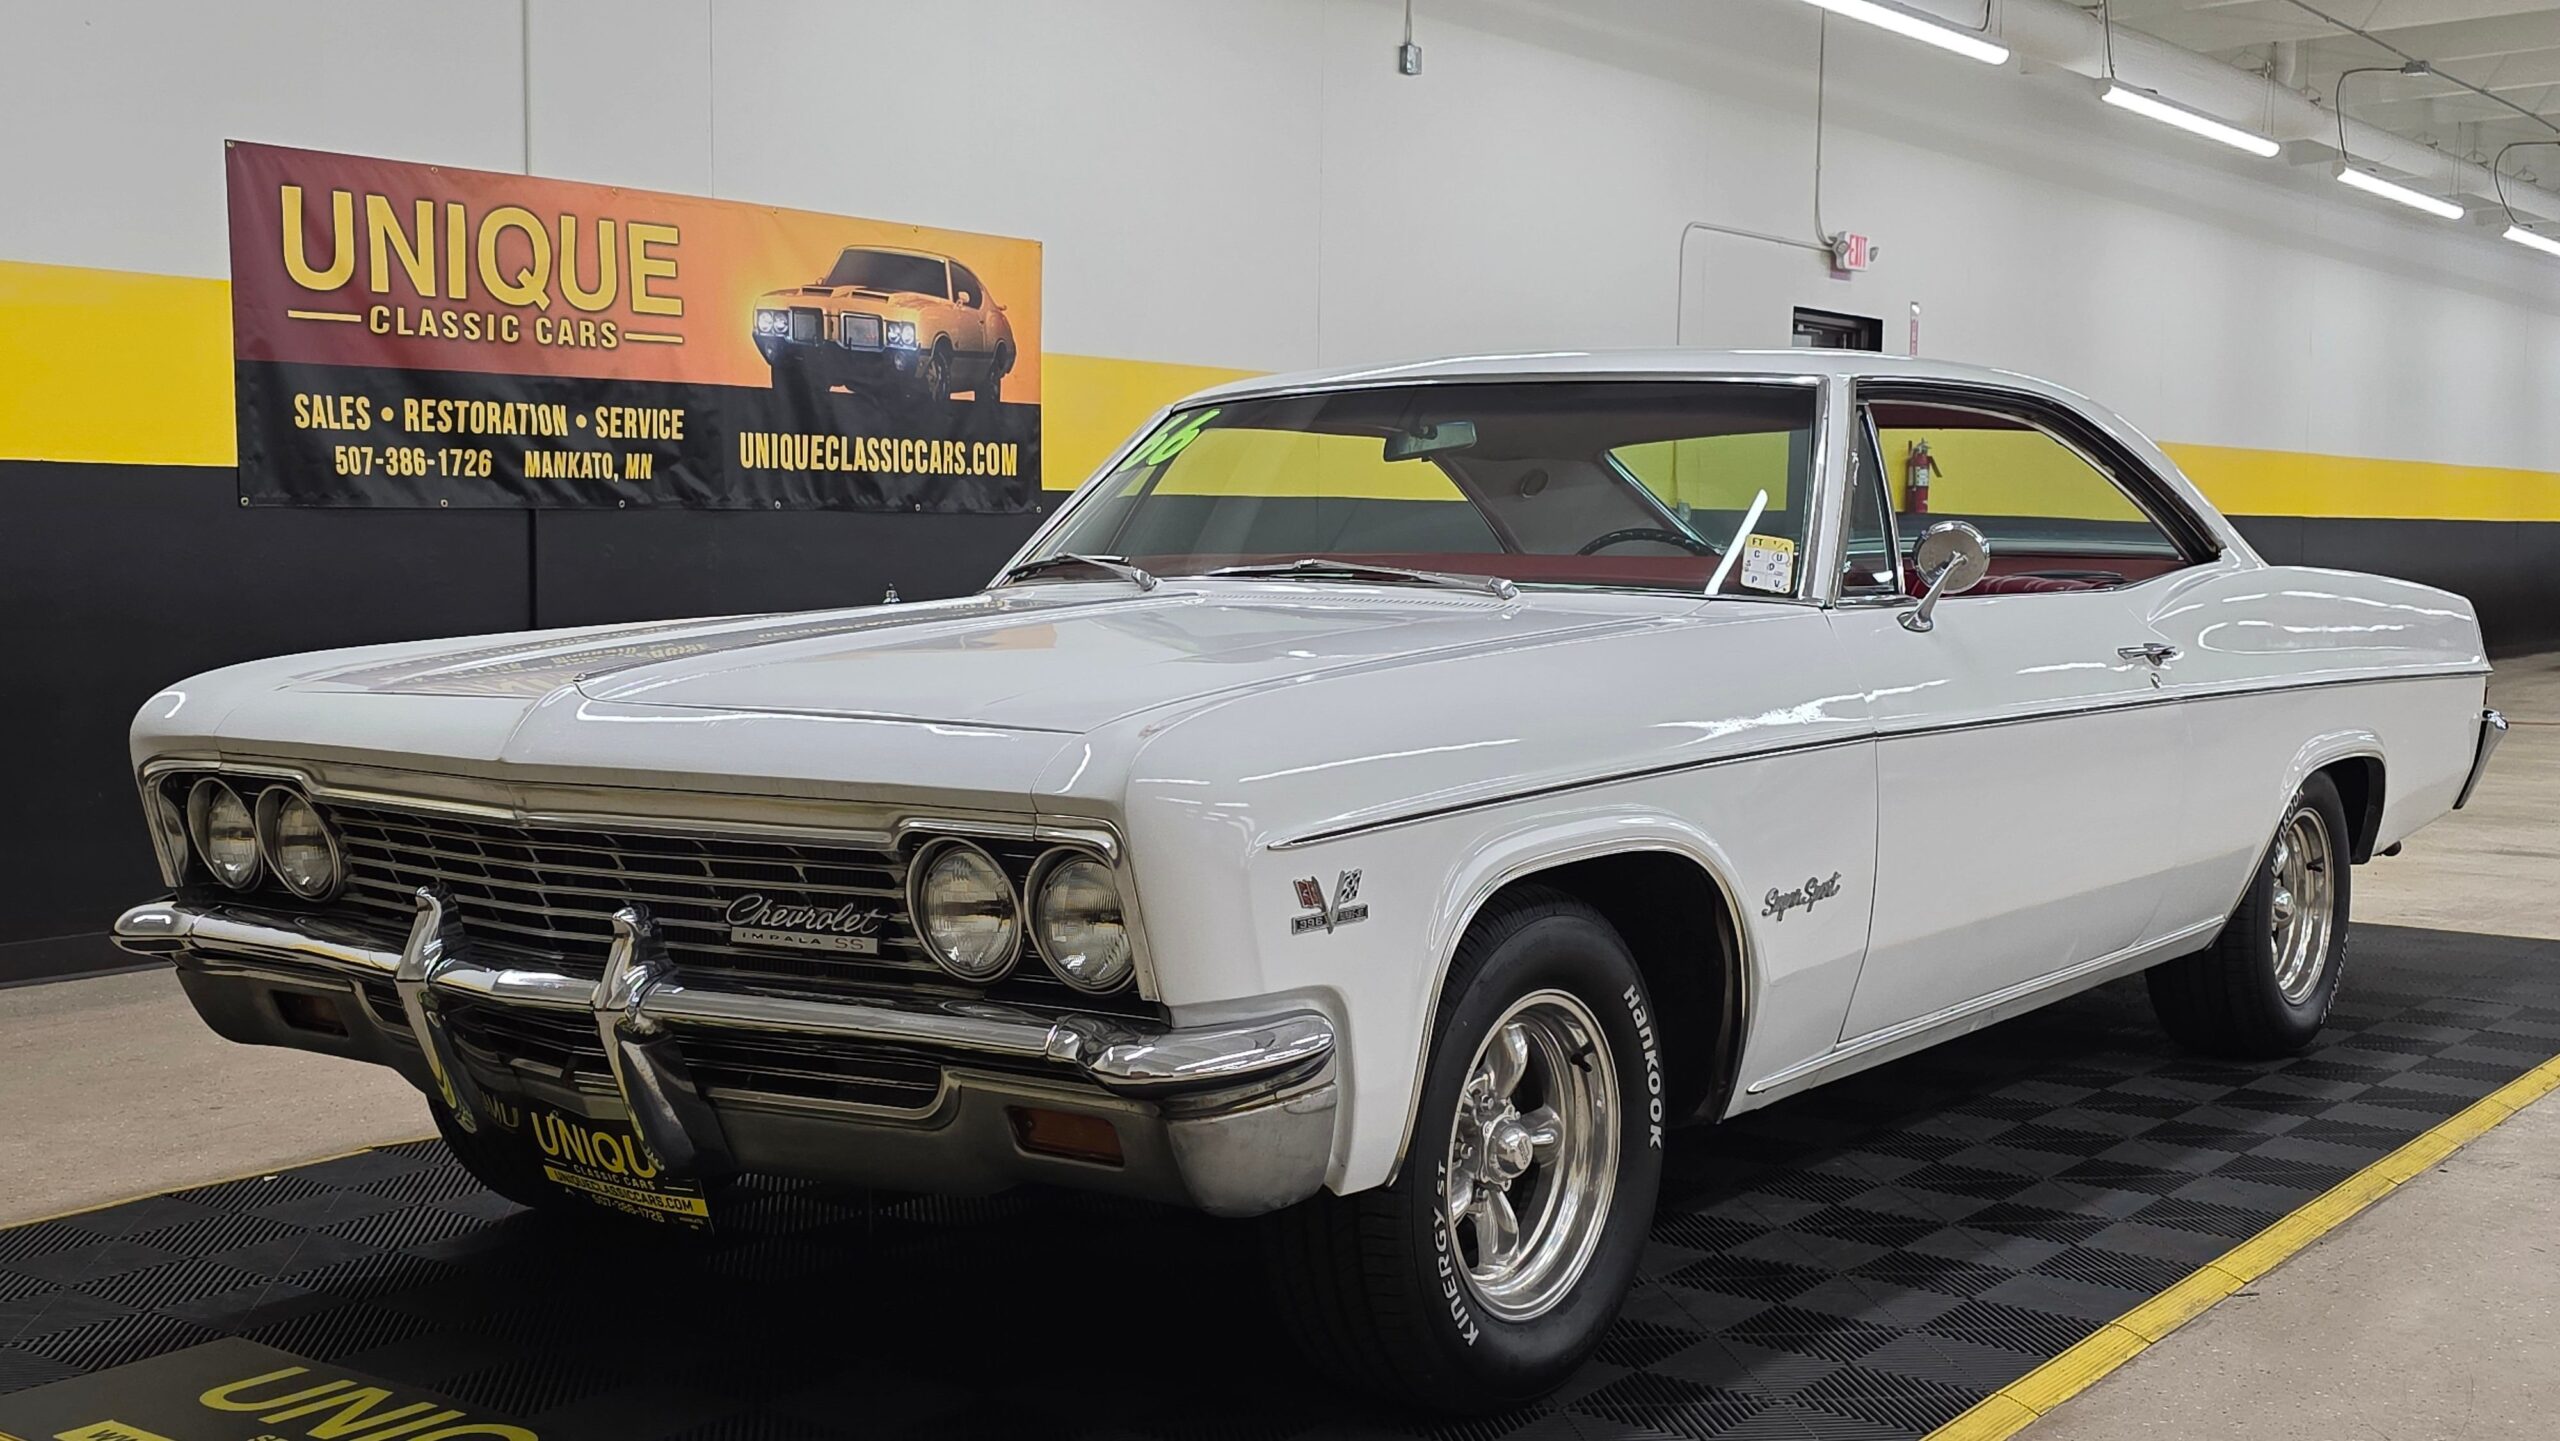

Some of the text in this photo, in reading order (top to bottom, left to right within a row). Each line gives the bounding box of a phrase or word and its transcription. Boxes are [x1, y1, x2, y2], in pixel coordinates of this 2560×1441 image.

[281, 185, 683, 316] UNIQUE
[369, 305, 619, 348] CLASSIC CARS
[294, 394, 685, 440] SALES RESTORATION SERVICE
[335, 446, 653, 482] 507-386-1726 MANKATO, MN
[739, 432, 1018, 476] UNIQUECLASSICCARS.COM
[726, 893, 889, 934] Chevrolet
[742, 932, 864, 951] IMPALA SS
[573, 1164, 656, 1191] CLASSIC CARS
[1435, 1159, 1446, 1197] ST
